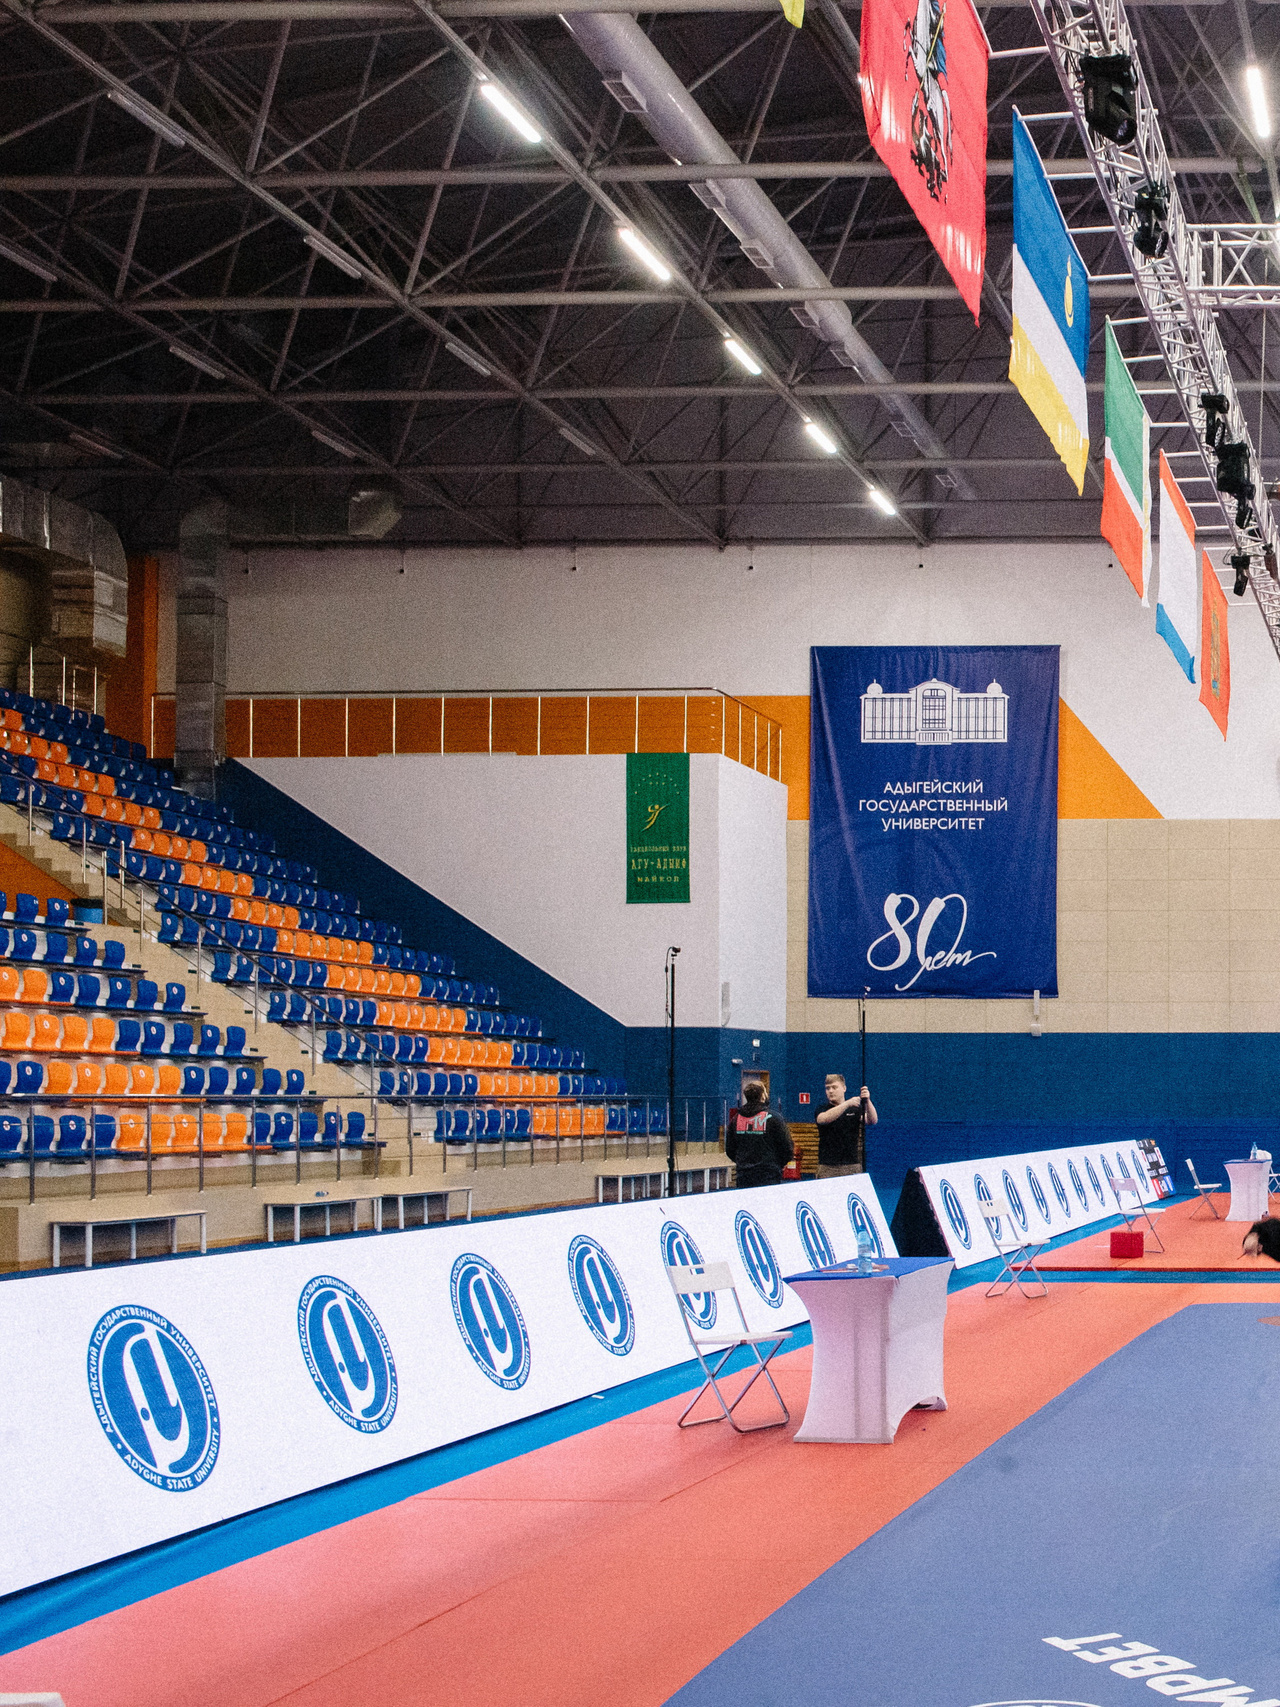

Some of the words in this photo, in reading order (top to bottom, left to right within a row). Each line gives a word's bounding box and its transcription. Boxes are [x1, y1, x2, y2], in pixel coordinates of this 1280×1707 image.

[858, 797, 1008, 814] ГОСУДАРСТВЕННЫЙ
[883, 780, 984, 795] АДЫГЕЙСКИЙ
[881, 817, 985, 831] УНИВЕРСИТЕТ
[867, 893, 967, 971] 80
[300, 1276, 354, 1310] ГОСУДАРСТВЕННЫЙ
[93, 1306, 168, 1347] ГОСУДАРСТВЕННЫЙ
[298, 1309, 320, 1382] АДЫГЕЙСКИЙ
[355, 1294, 394, 1365] УНИВЕРСИТЕТ
[89, 1346, 114, 1433] АДЫГЕЙСКИЙ
[170, 1326, 217, 1409] УНИВЕРСИТЕТ
[329, 1400, 358, 1428] ADYGHE
[360, 1421, 381, 1432] STATE
[380, 1382, 398, 1427] UNIVERSITY
[124, 1453, 163, 1486] ADYGHE
[167, 1478, 194, 1490] STATE
[194, 1429, 220, 1483] UNIVERSITY
